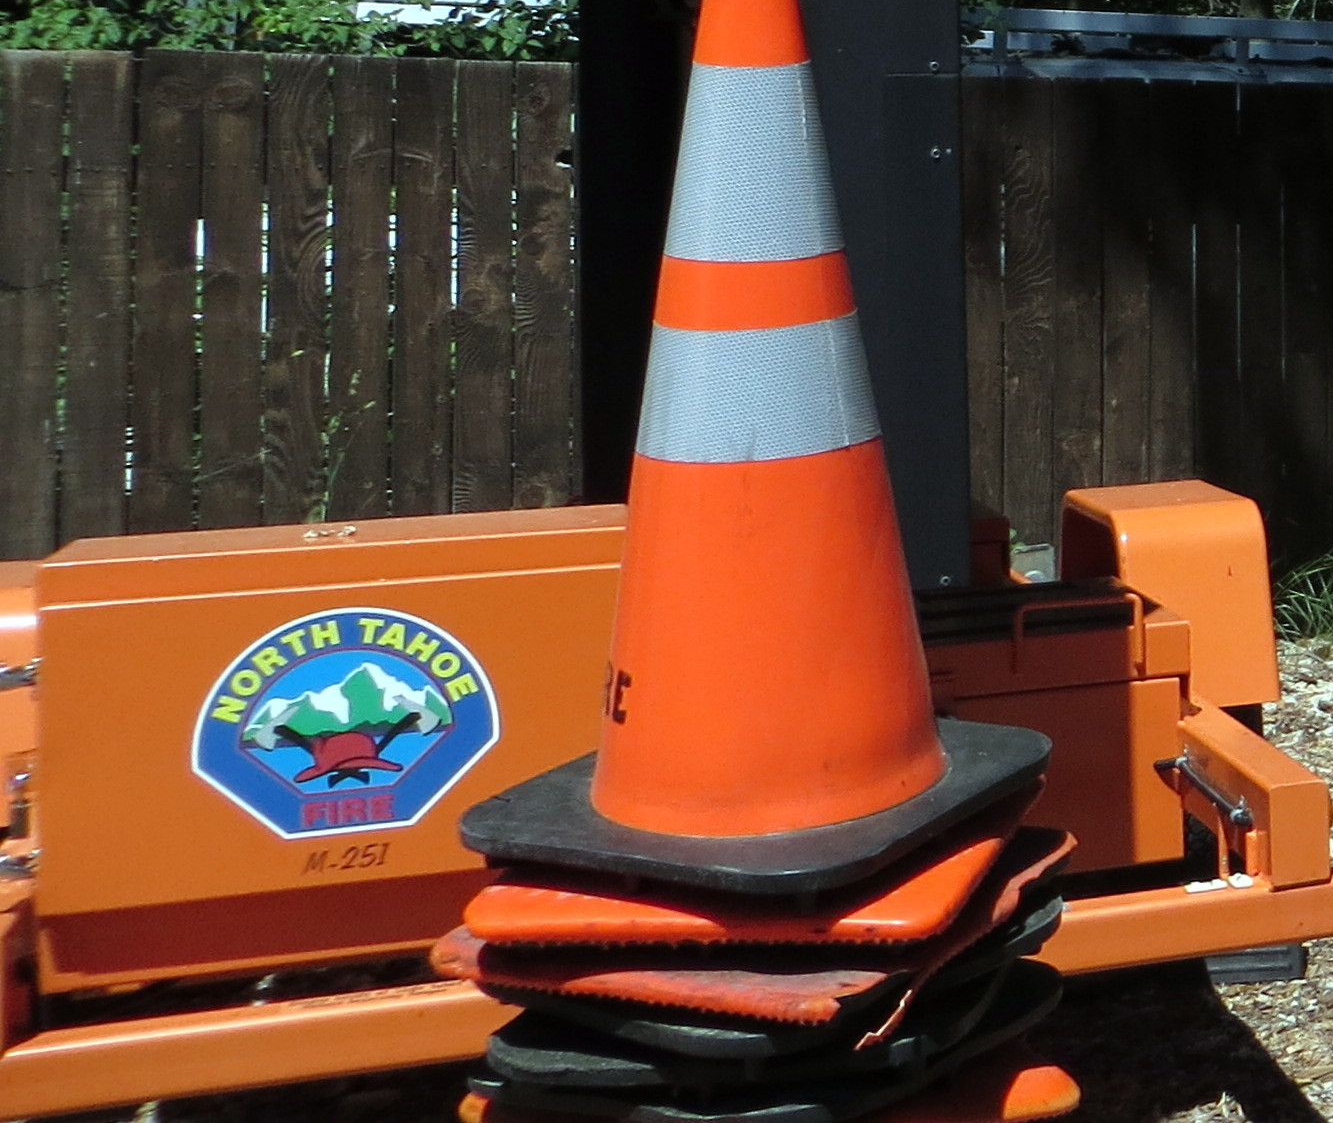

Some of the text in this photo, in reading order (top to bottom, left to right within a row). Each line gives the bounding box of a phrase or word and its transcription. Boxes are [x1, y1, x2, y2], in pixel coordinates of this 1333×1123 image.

[211, 617, 480, 723] NORTH TAHOE
[303, 794, 395, 826] FIRE
